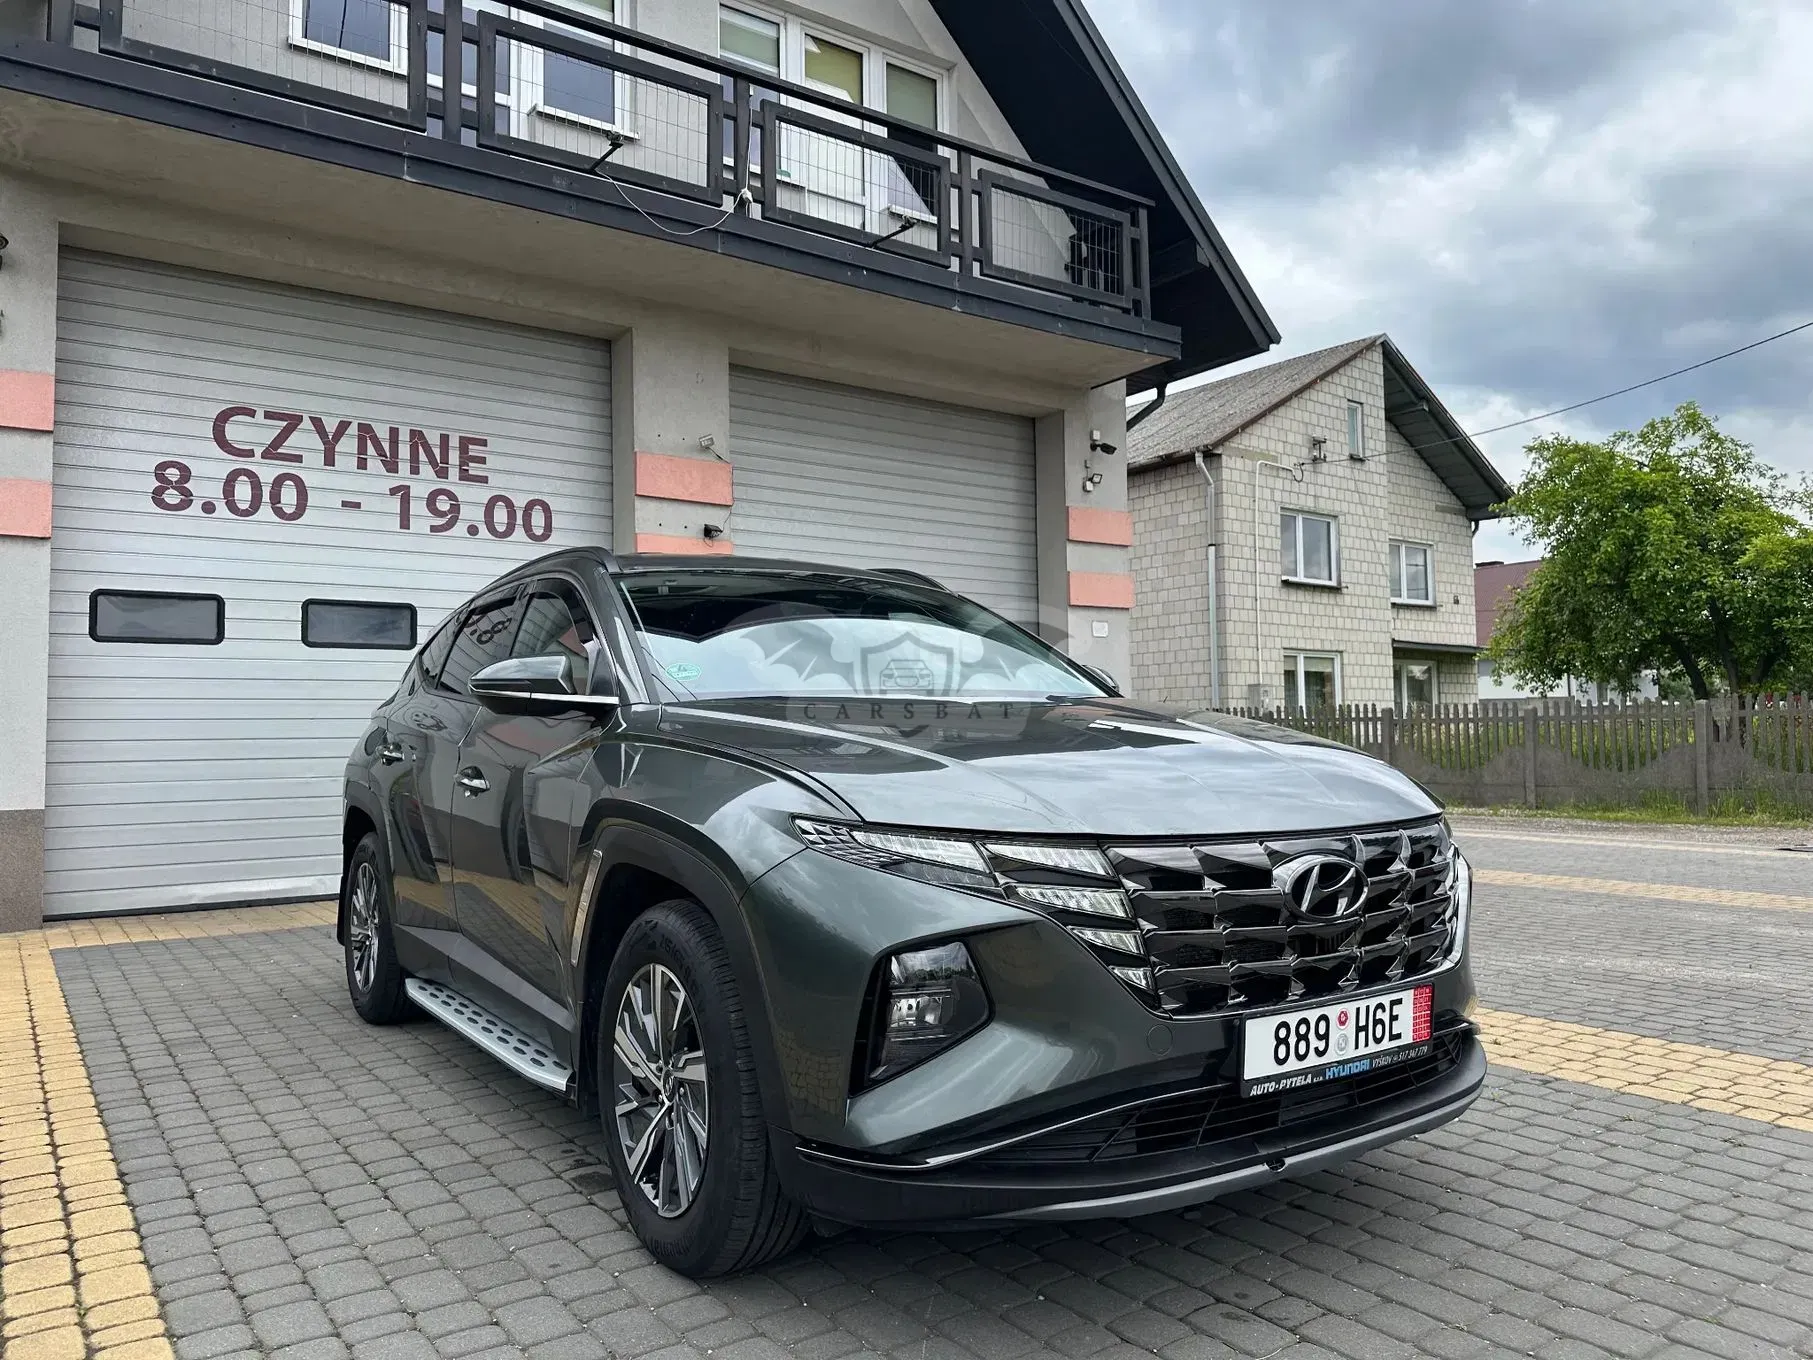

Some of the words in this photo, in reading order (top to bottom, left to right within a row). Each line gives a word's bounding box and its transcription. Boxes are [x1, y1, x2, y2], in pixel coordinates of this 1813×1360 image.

[212, 406, 489, 484] CZYNNE
[151, 460, 309, 522] 8.00
[341, 500, 362, 509] -
[389, 484, 553, 542] 19.00
[1273, 1013, 1331, 1066] 889
[1354, 998, 1403, 1050] H6E
[1326, 1059, 1370, 1080] HYUNDAI
